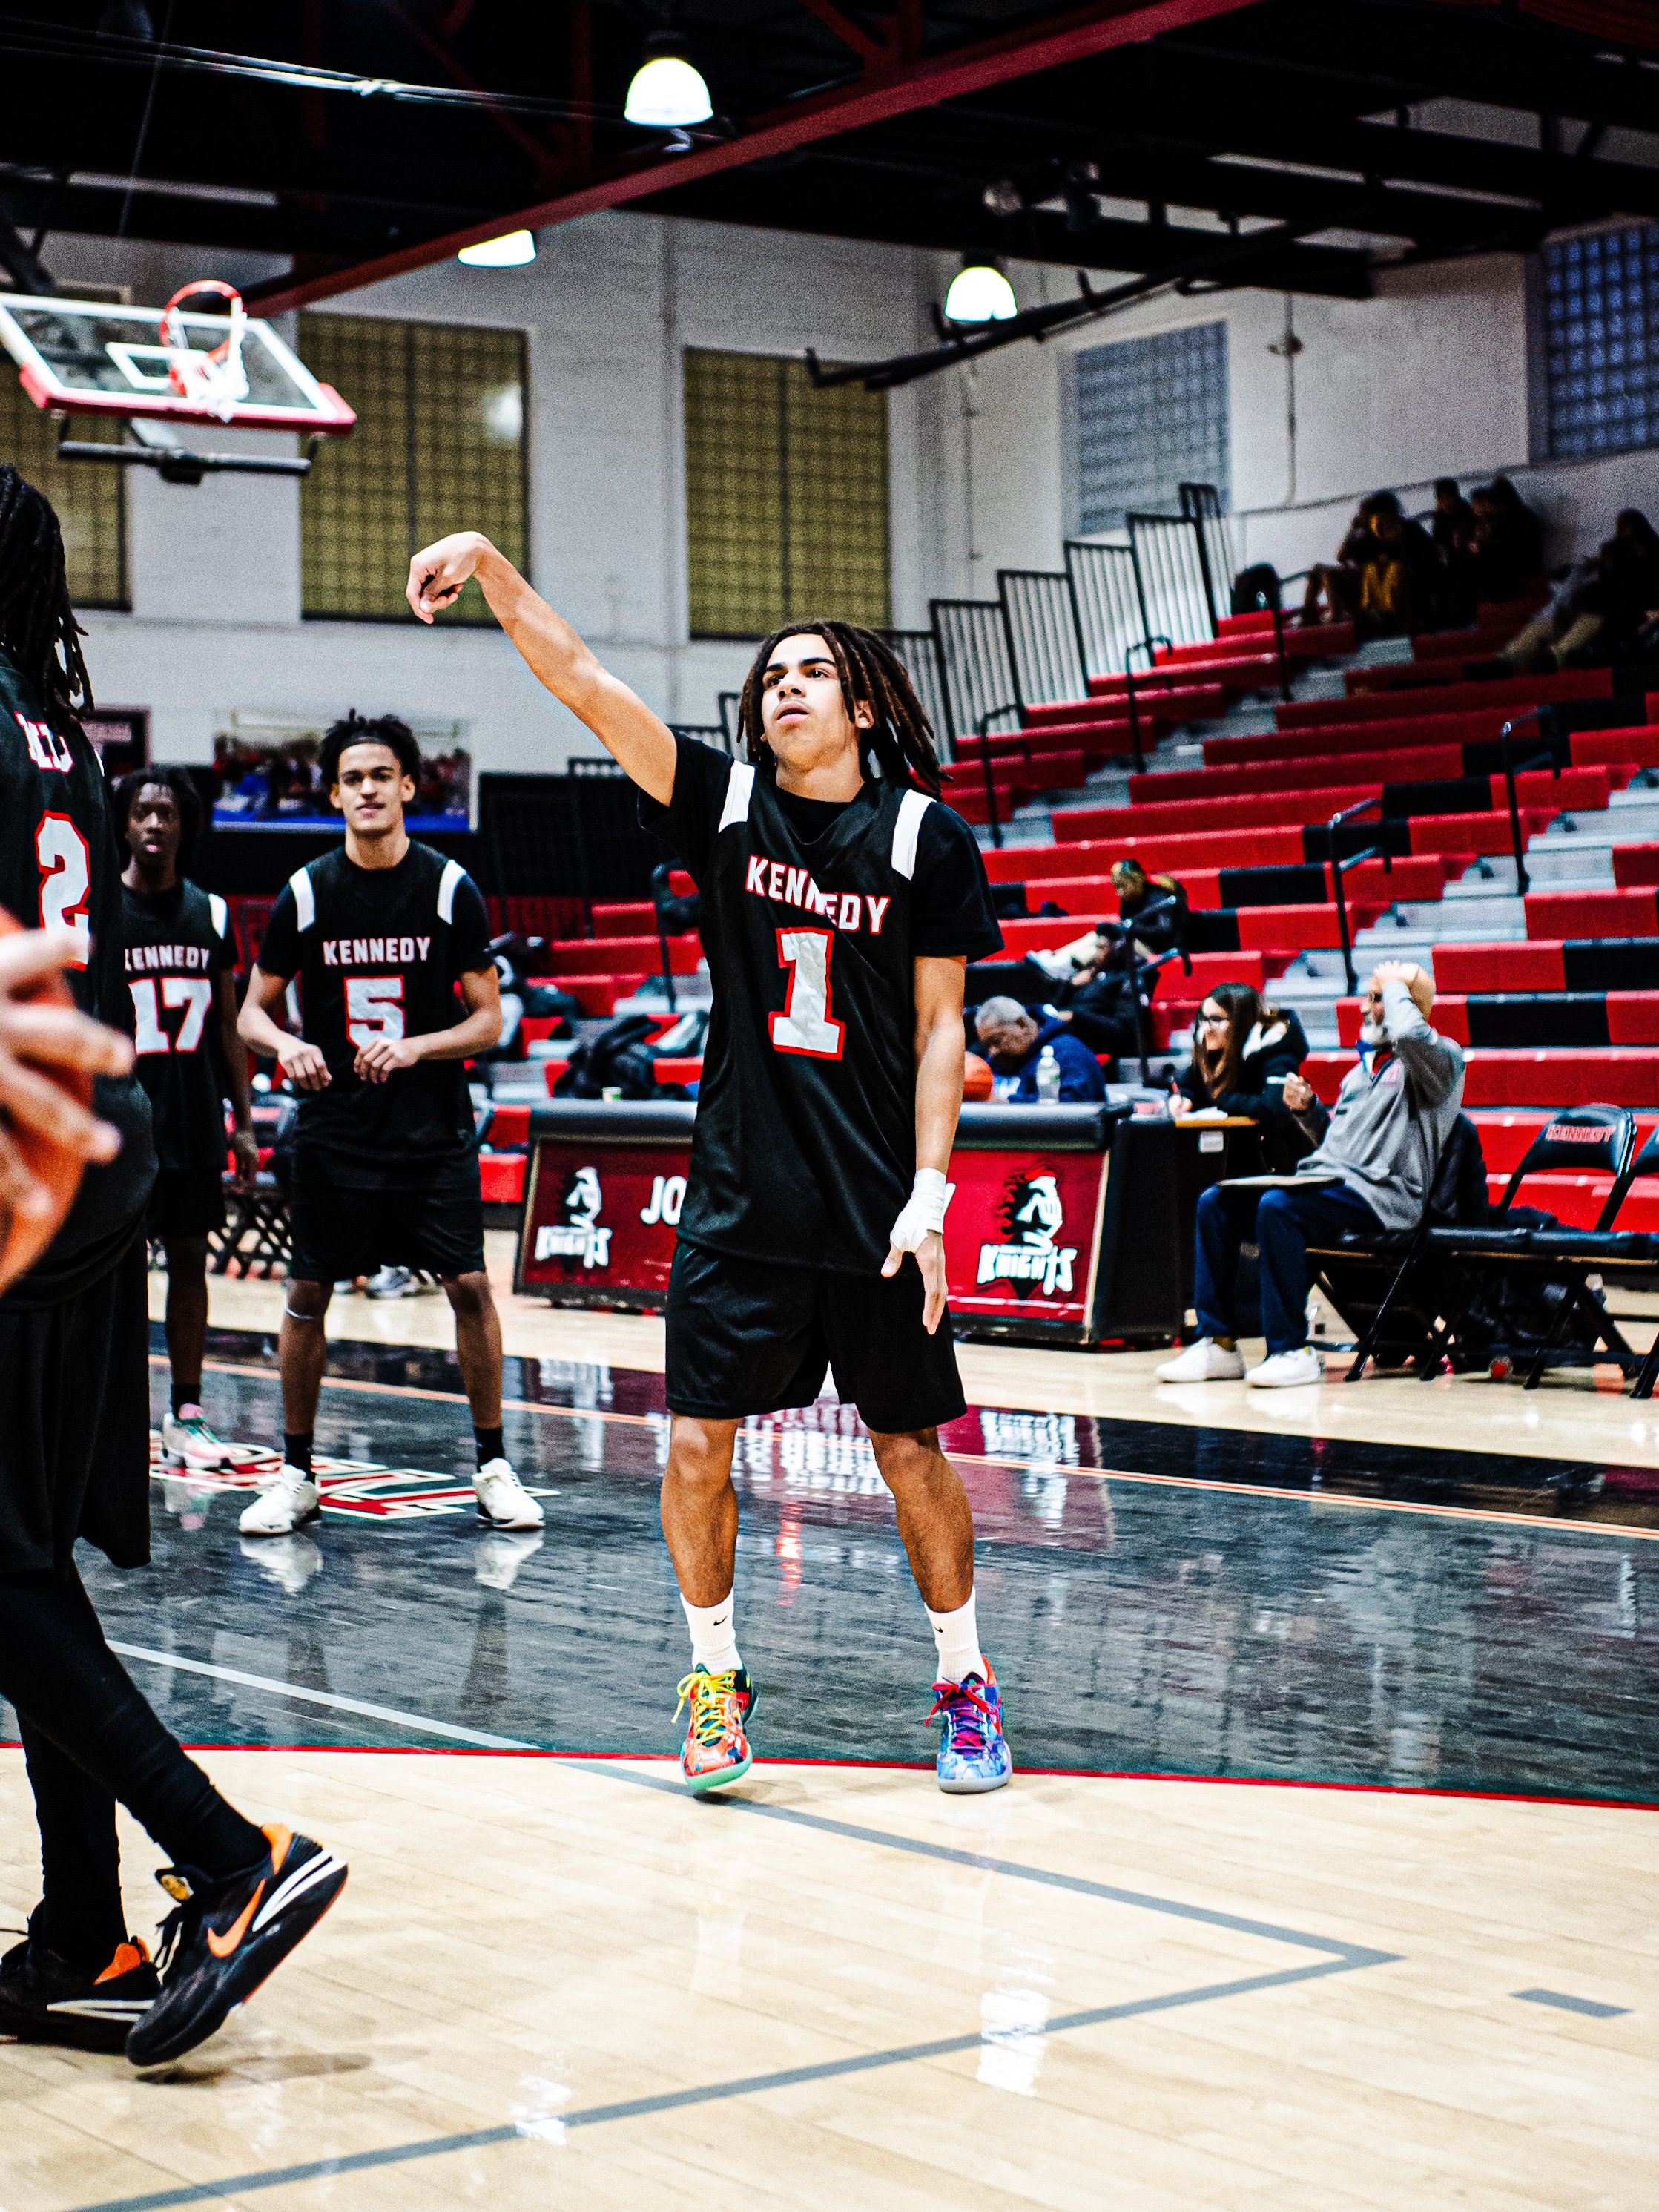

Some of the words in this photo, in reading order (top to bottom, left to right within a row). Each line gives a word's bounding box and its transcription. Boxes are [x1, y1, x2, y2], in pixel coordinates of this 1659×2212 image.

[745, 854, 891, 935] KENNEDY
[125, 945, 210, 972] KENNEDY
[323, 936, 431, 965] KENNEDY
[128, 977, 213, 1055] 17
[343, 975, 406, 1049] 5
[768, 926, 845, 1061] 1
[977, 1243, 1078, 1296] KNIGHTS
